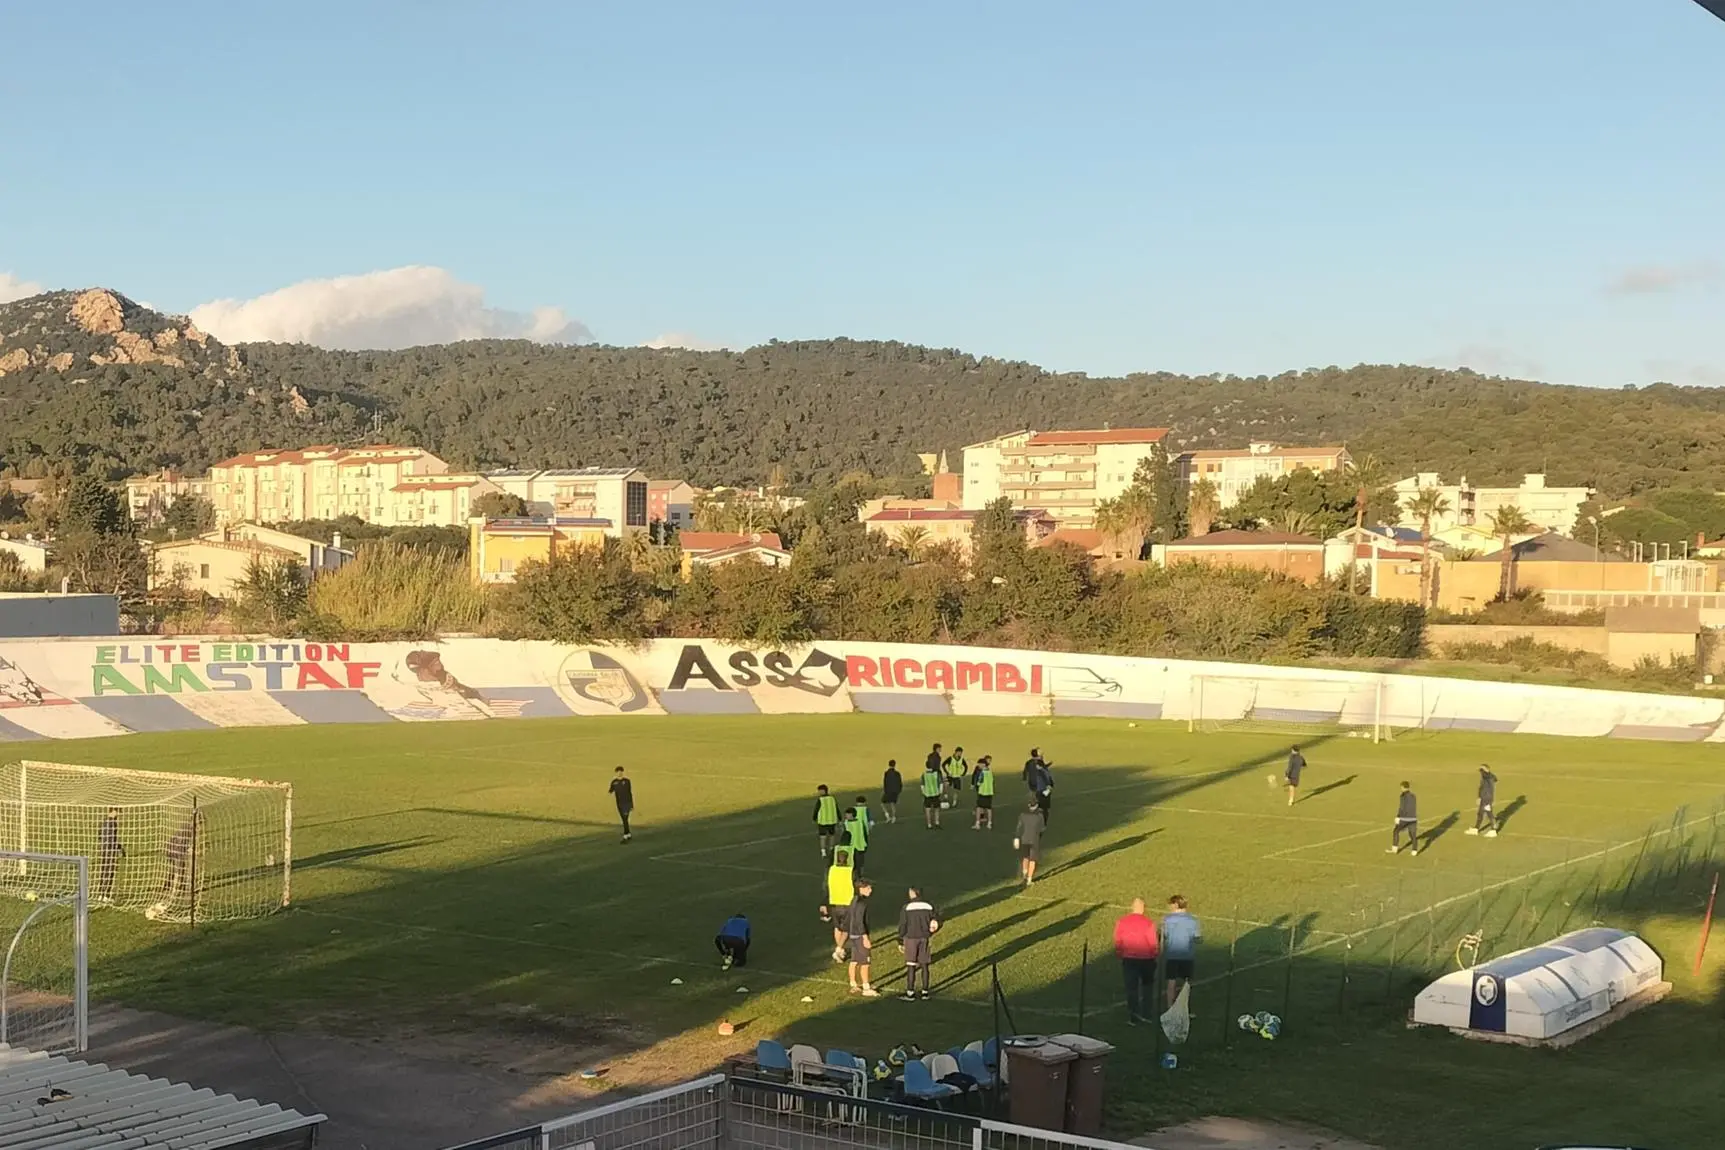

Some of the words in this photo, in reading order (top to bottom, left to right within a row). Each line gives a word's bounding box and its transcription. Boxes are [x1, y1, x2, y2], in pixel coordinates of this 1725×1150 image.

[95, 644, 200, 663] ELITE
[212, 643, 350, 661] EDITION
[91, 661, 382, 696] AMSTAF
[846, 655, 1043, 694] RICAMBI
